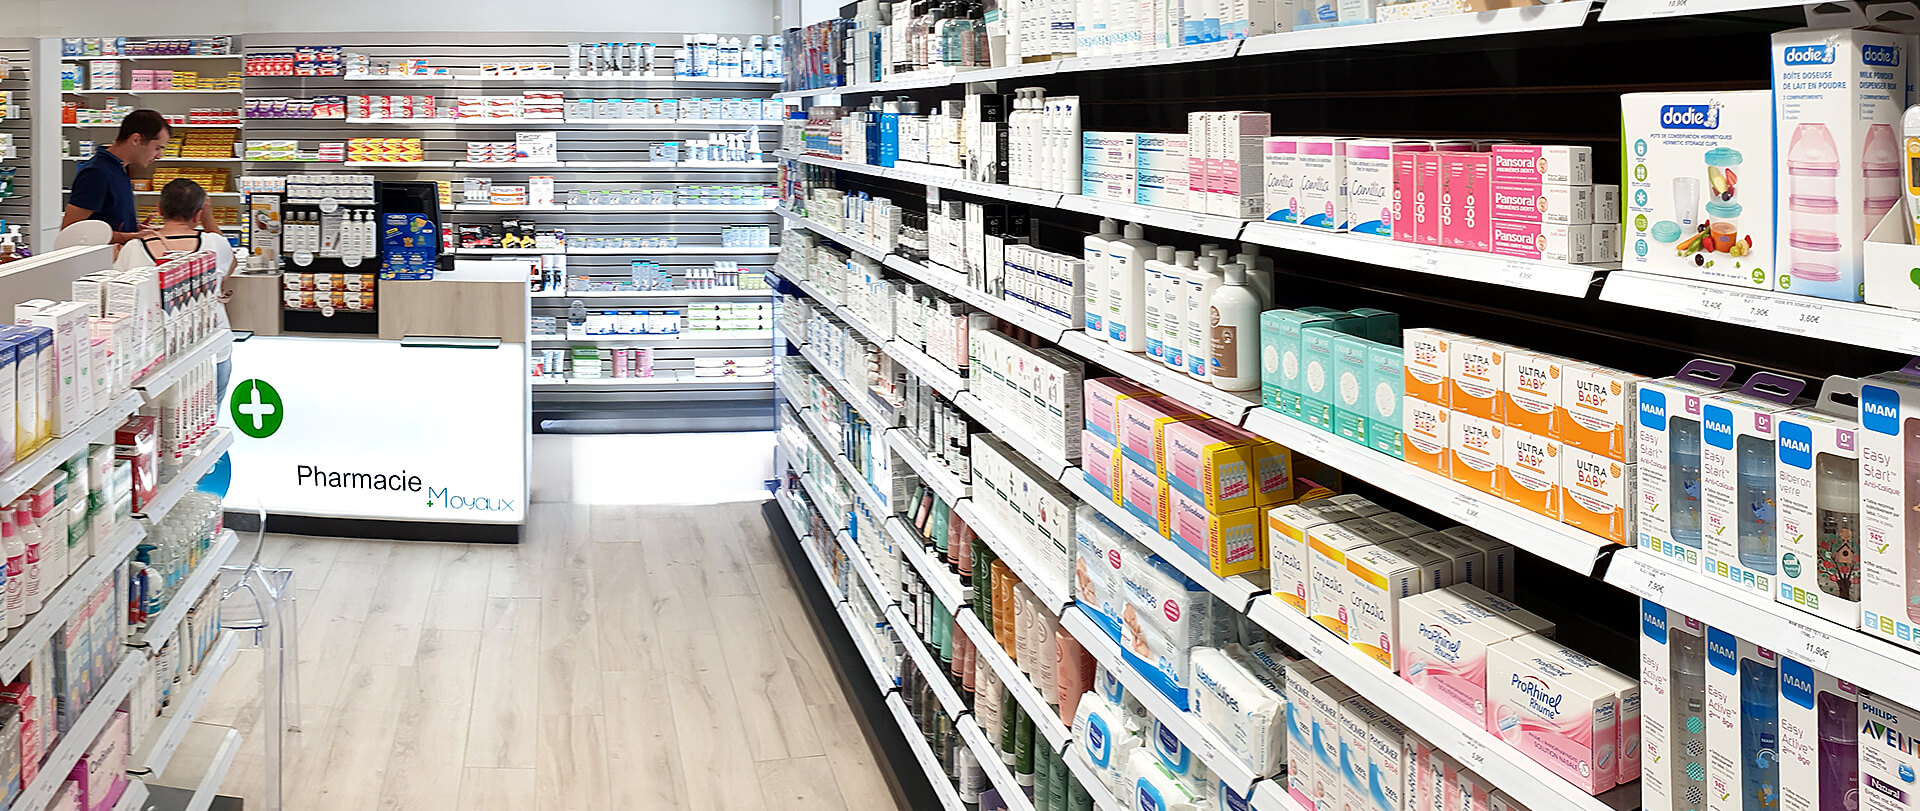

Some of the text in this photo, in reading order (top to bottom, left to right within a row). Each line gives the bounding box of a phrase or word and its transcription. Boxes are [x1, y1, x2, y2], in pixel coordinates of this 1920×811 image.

[1787, 47, 1822, 62] dodie
[1864, 47, 1891, 62] dodie
[1802, 71, 1832, 79] DOSEUSE
[1663, 107, 1704, 125] dodie
[1496, 155, 1535, 168] Pansoral
[1495, 193, 1535, 207] Pansoral
[1494, 229, 1534, 244] Pansoral
[1518, 364, 1546, 379] ULTRA
[1519, 375, 1546, 390] BABY
[1576, 379, 1607, 396] ULTRA
[1578, 390, 1606, 407] BABY
[1641, 403, 1664, 417] MAM
[1864, 402, 1897, 419] MAM
[1705, 419, 1731, 435] MAM
[1516, 440, 1544, 457] ULTRA
[1781, 437, 1810, 453] MAM
[1518, 450, 1544, 467] BABY
[1704, 449, 1725, 466] Easy
[1863, 447, 1891, 468] Easy
[1576, 460, 1607, 477] ULTRA
[297, 465, 422, 492] Pharmacie
[1578, 470, 1606, 487] BABY
[1780, 470, 1812, 488] Biberon
[1780, 483, 1801, 497] verre
[428, 486, 515, 512] Moyaux
[1644, 613, 1665, 630] MAM
[1418, 623, 1461, 653] ProRhinel
[1434, 644, 1460, 664] Rhume
[1709, 641, 1735, 660] MAM
[1806, 643, 1830, 659] 11,90€
[1643, 653, 1659, 671] Easy
[1783, 673, 1812, 694] MAM
[1511, 673, 1562, 715] ProRhinel
[1708, 684, 1728, 703] Easy
[1529, 698, 1555, 720] Rhume
[1862, 702, 1898, 724] PHILIPS
[1781, 718, 1803, 739] Easy
